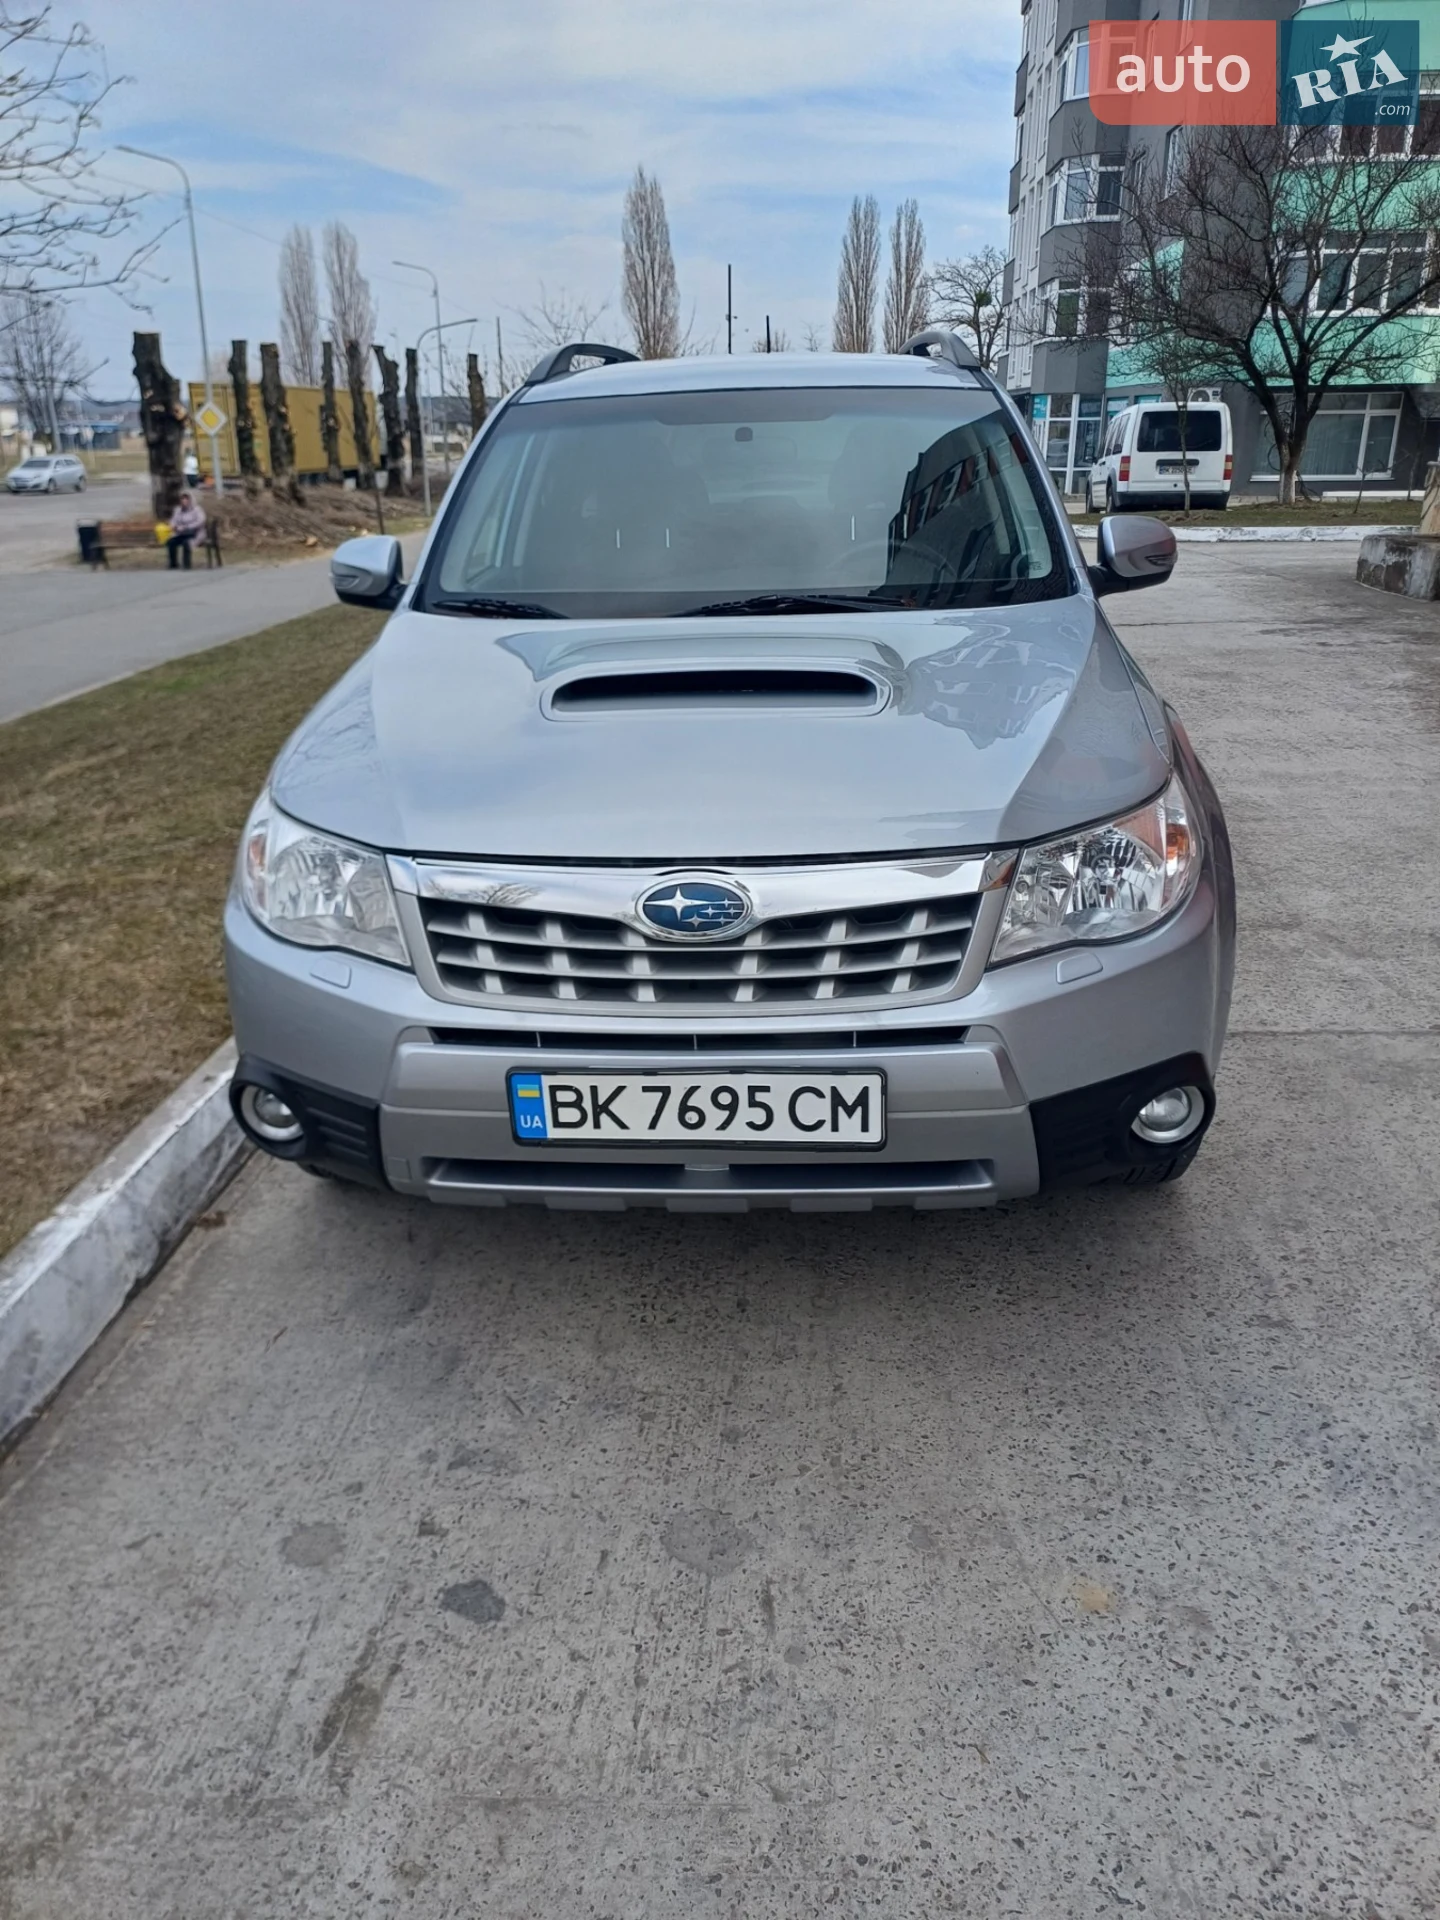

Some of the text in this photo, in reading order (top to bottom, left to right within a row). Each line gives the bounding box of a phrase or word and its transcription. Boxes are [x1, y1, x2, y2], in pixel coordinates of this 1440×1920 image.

[520, 1114, 543, 1129] UA
[548, 1084, 870, 1132] BK 7695 CM
